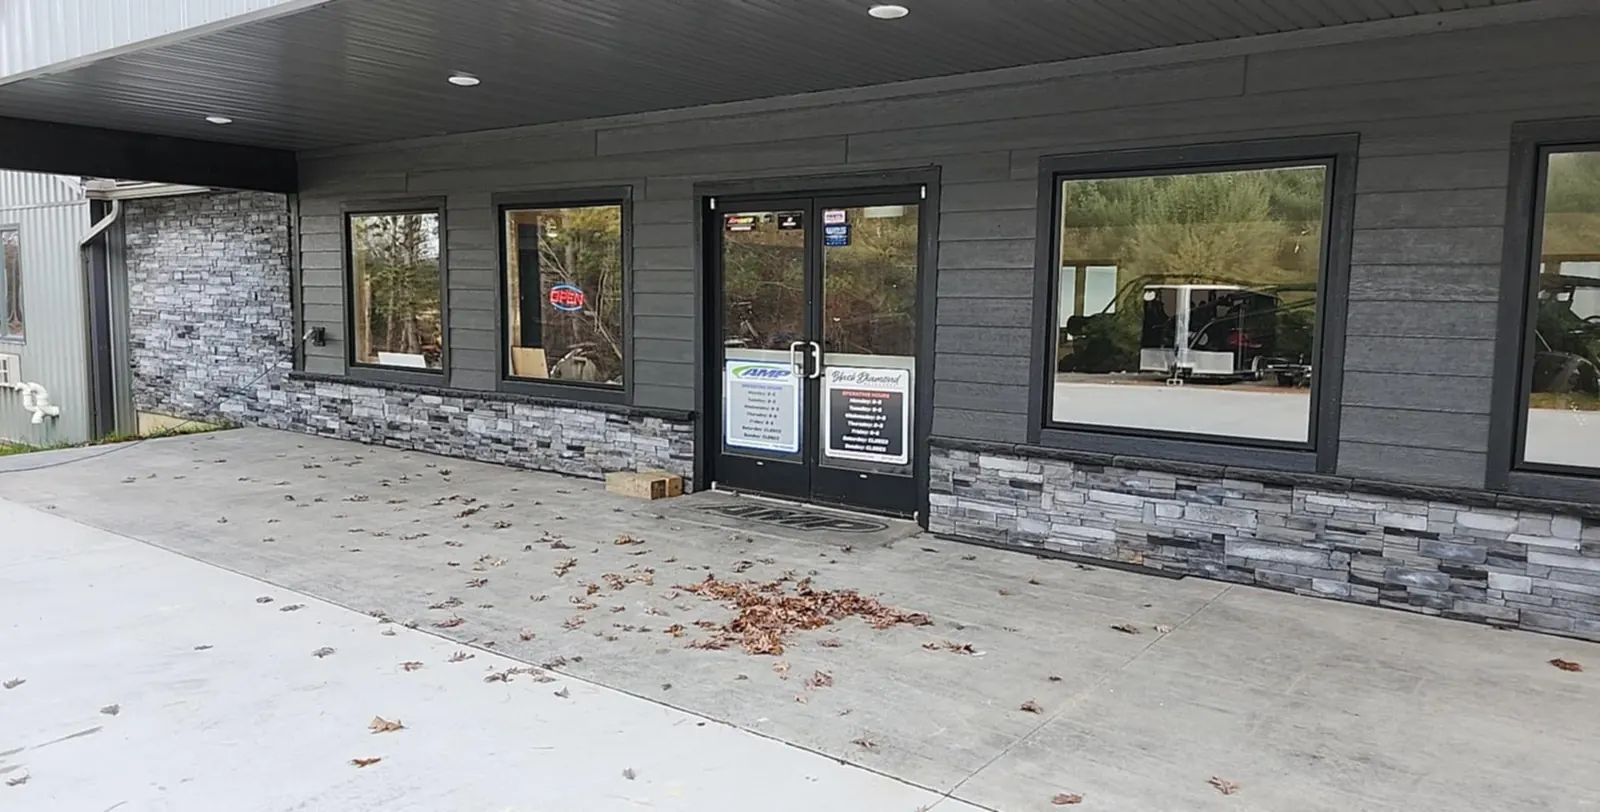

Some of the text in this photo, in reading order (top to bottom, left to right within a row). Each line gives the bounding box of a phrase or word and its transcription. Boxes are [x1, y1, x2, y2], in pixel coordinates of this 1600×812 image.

[550, 290, 584, 305] OPEN
[742, 368, 792, 378] AMP
[832, 370, 902, 385] Black Diamond
